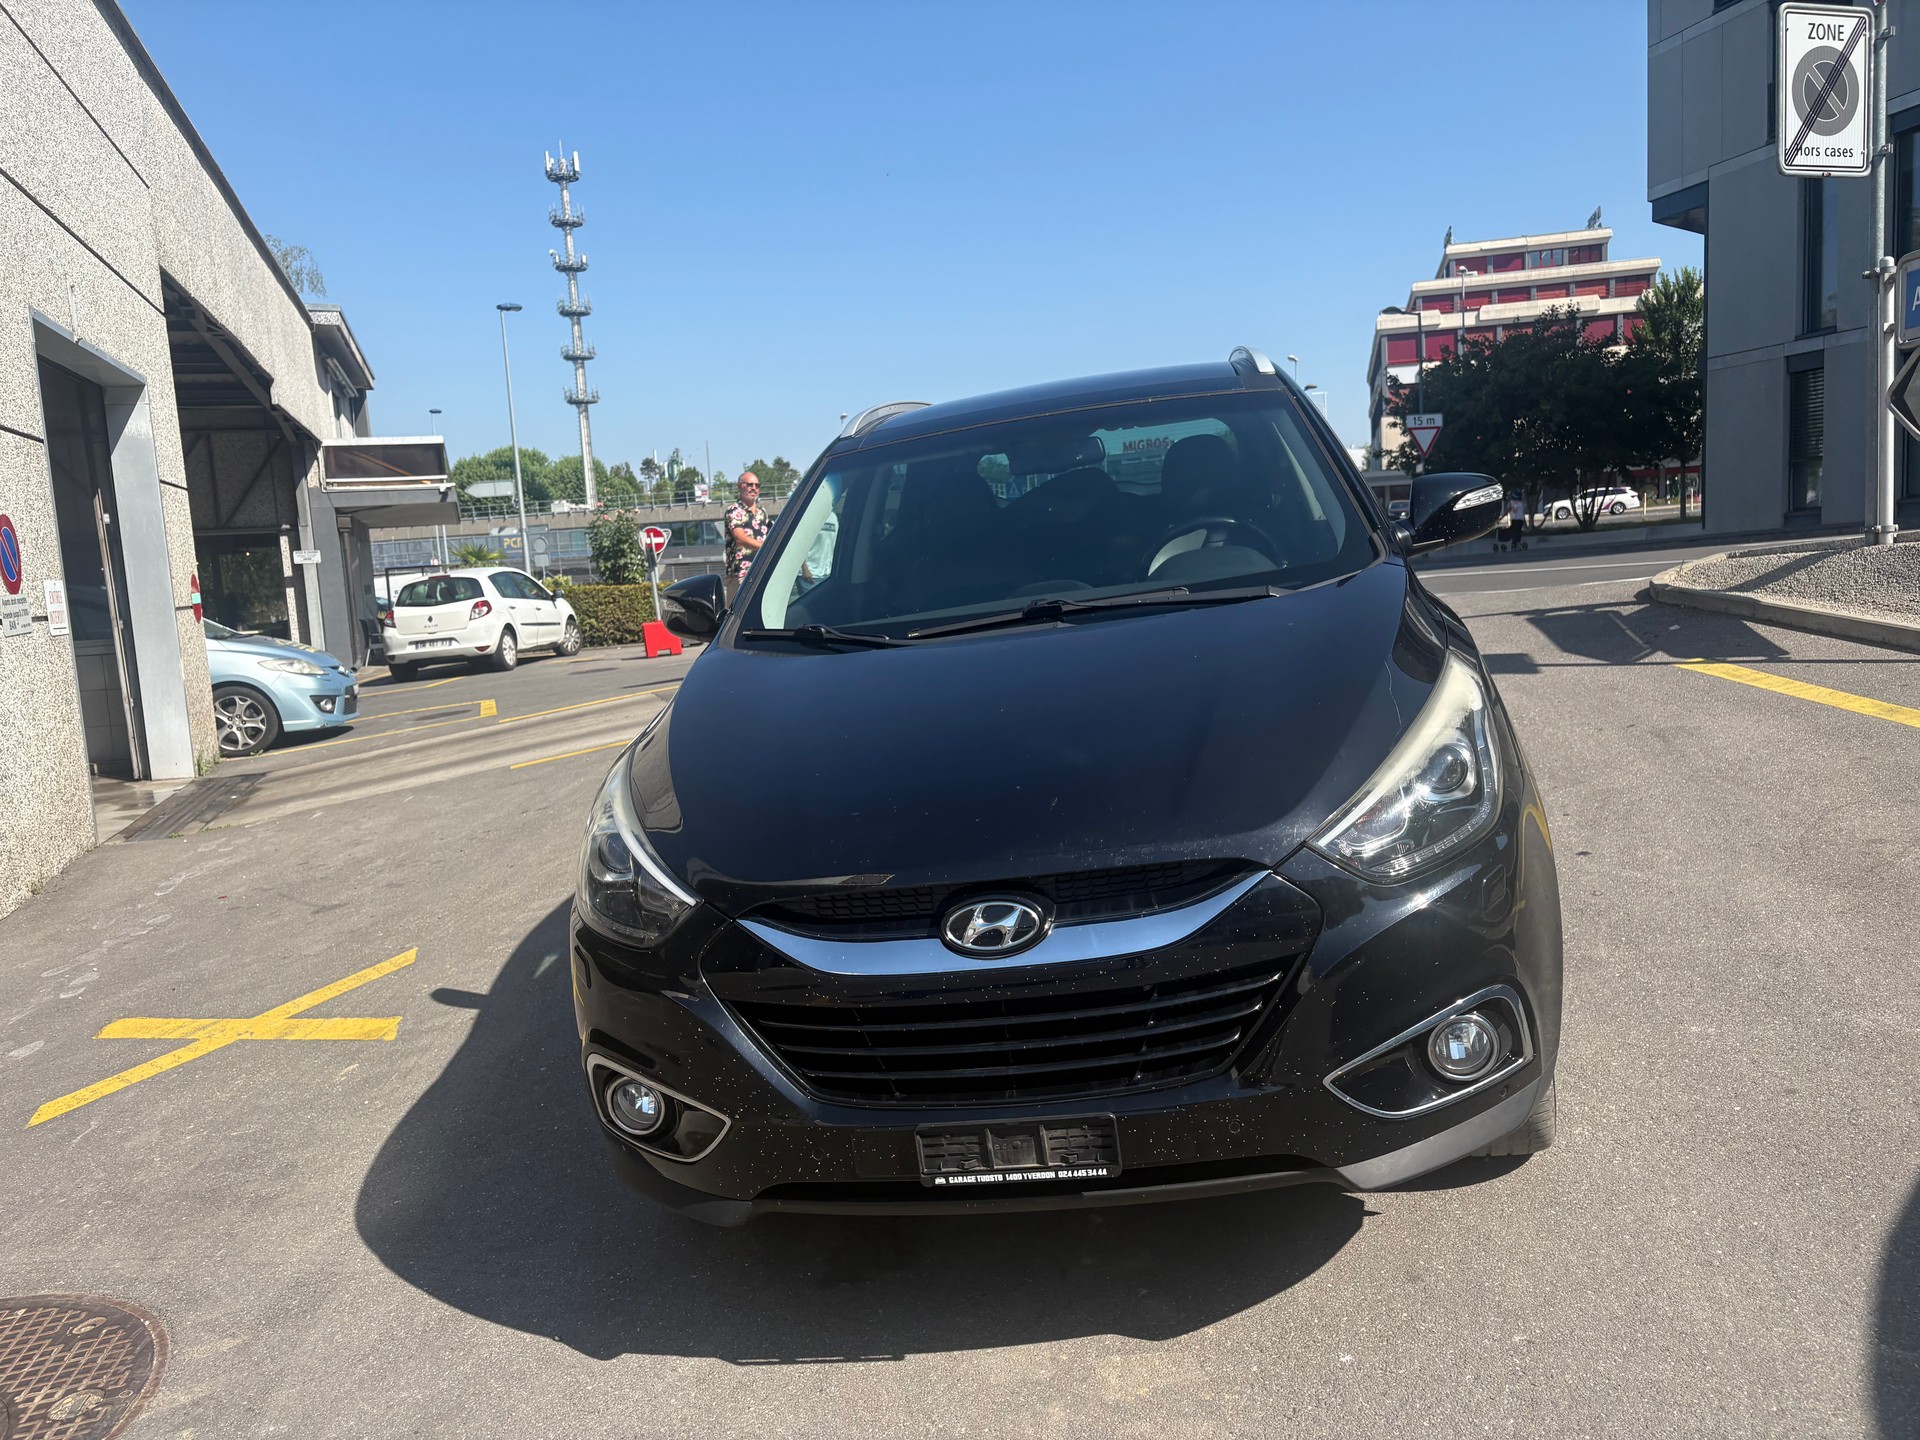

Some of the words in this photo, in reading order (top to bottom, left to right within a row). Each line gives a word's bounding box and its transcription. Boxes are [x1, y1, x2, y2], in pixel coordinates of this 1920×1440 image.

[1808, 22, 1845, 41] ZONE
[1825, 146, 1854, 158] cases
[1413, 416, 1423, 426] 15
[1426, 417, 1436, 425] m
[1122, 437, 1171, 453] MIGROS
[948, 1175, 976, 1184] GARAGE
[1005, 1172, 1022, 1181] 1400
[1022, 1171, 1056, 1180] YVERDON
[1058, 1170, 1072, 1178] 024
[1073, 1169, 1087, 1177] 445
[1087, 1168, 1097, 1176] 34
[1097, 1168, 1108, 1176] 44
